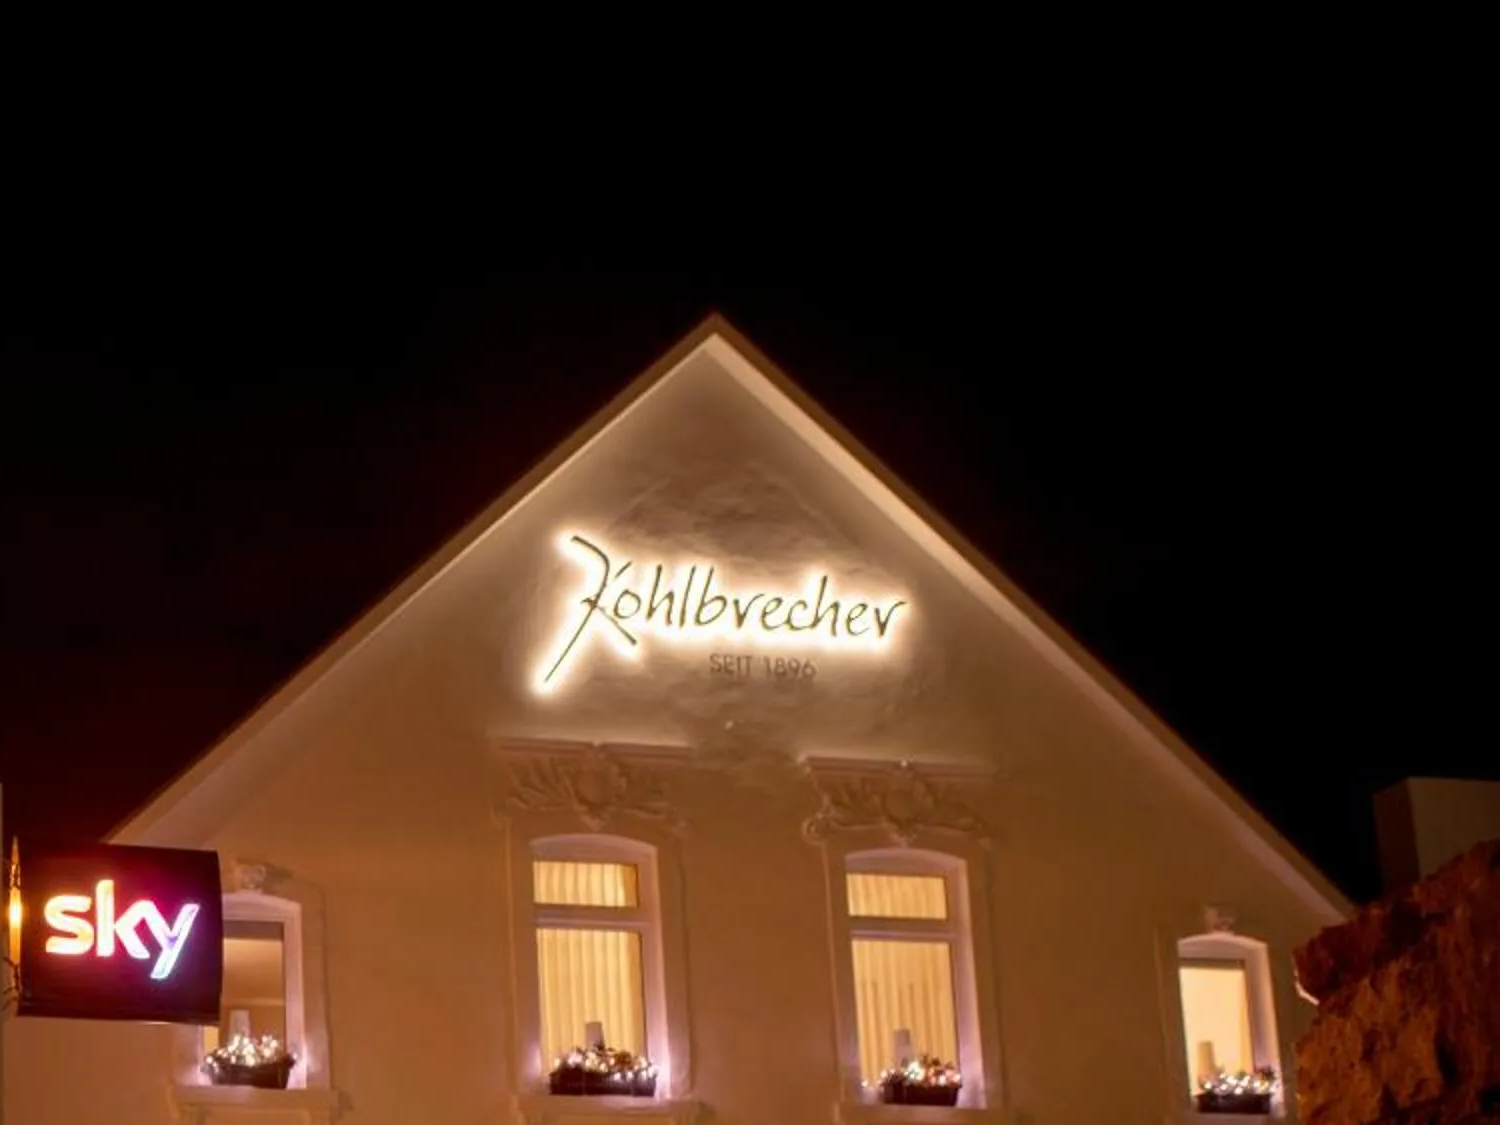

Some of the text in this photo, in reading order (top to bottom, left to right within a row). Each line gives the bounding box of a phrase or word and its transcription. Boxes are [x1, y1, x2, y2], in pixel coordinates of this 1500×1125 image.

[543, 534, 908, 683] Kohlbrecher
[709, 652, 818, 679] SEIT 1896
[44, 879, 200, 980] sky
